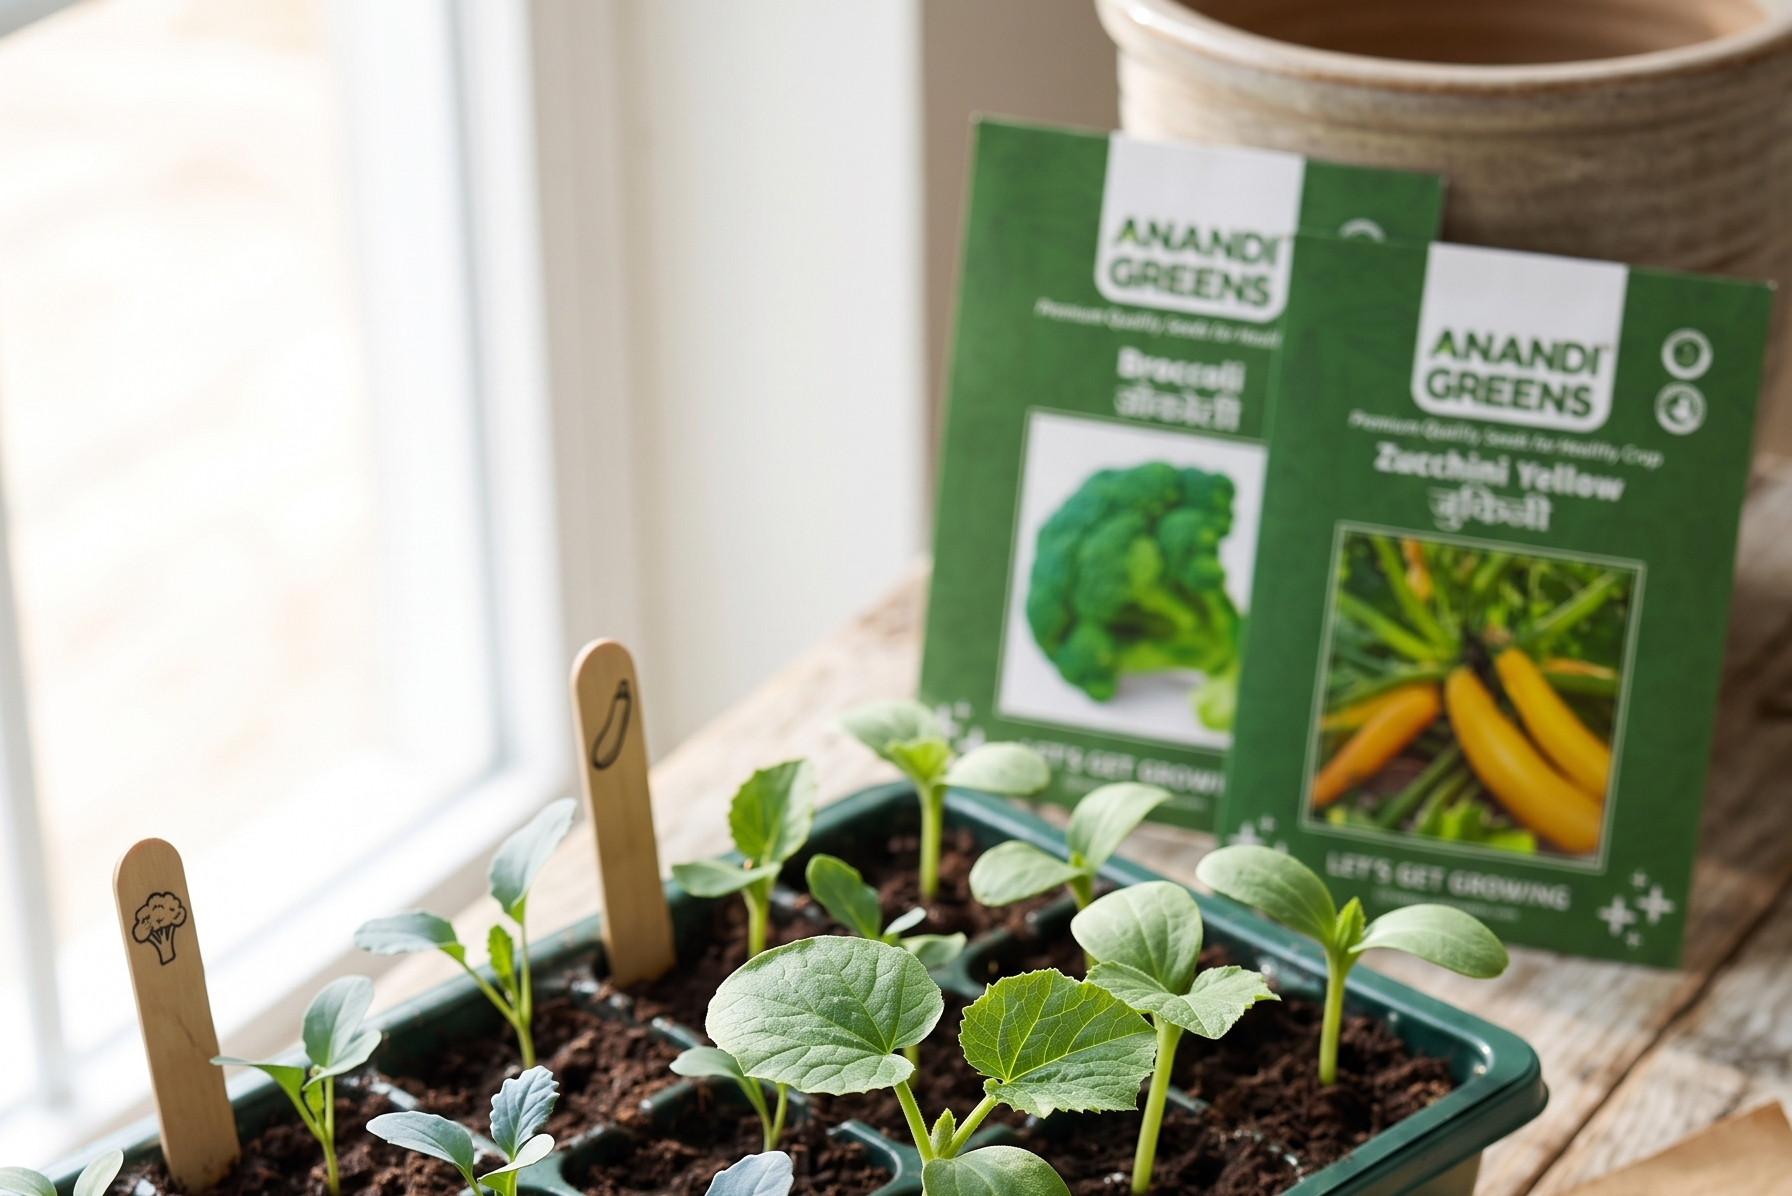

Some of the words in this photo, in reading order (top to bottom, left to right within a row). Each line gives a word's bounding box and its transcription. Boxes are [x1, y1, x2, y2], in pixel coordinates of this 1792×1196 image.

[1116, 218, 1279, 266] ANANDI
[1109, 256, 1271, 307] GREENS
[1116, 346, 1246, 394] Broccoli
[1433, 328, 1601, 376] ANANDI
[1426, 367, 1593, 418] GREENS
[1347, 408, 1421, 437] Premium
[1421, 417, 1482, 447] Quality
[1557, 438, 1620, 465] Healthy
[1620, 443, 1665, 470] Crop
[1374, 441, 1511, 488] Zucchini
[1517, 459, 1626, 502] Yellow
[1085, 750, 1135, 781] GET
[1325, 851, 1393, 885] LET'S
[1394, 861, 1446, 892] GET
[1447, 869, 1572, 912] GROWING
